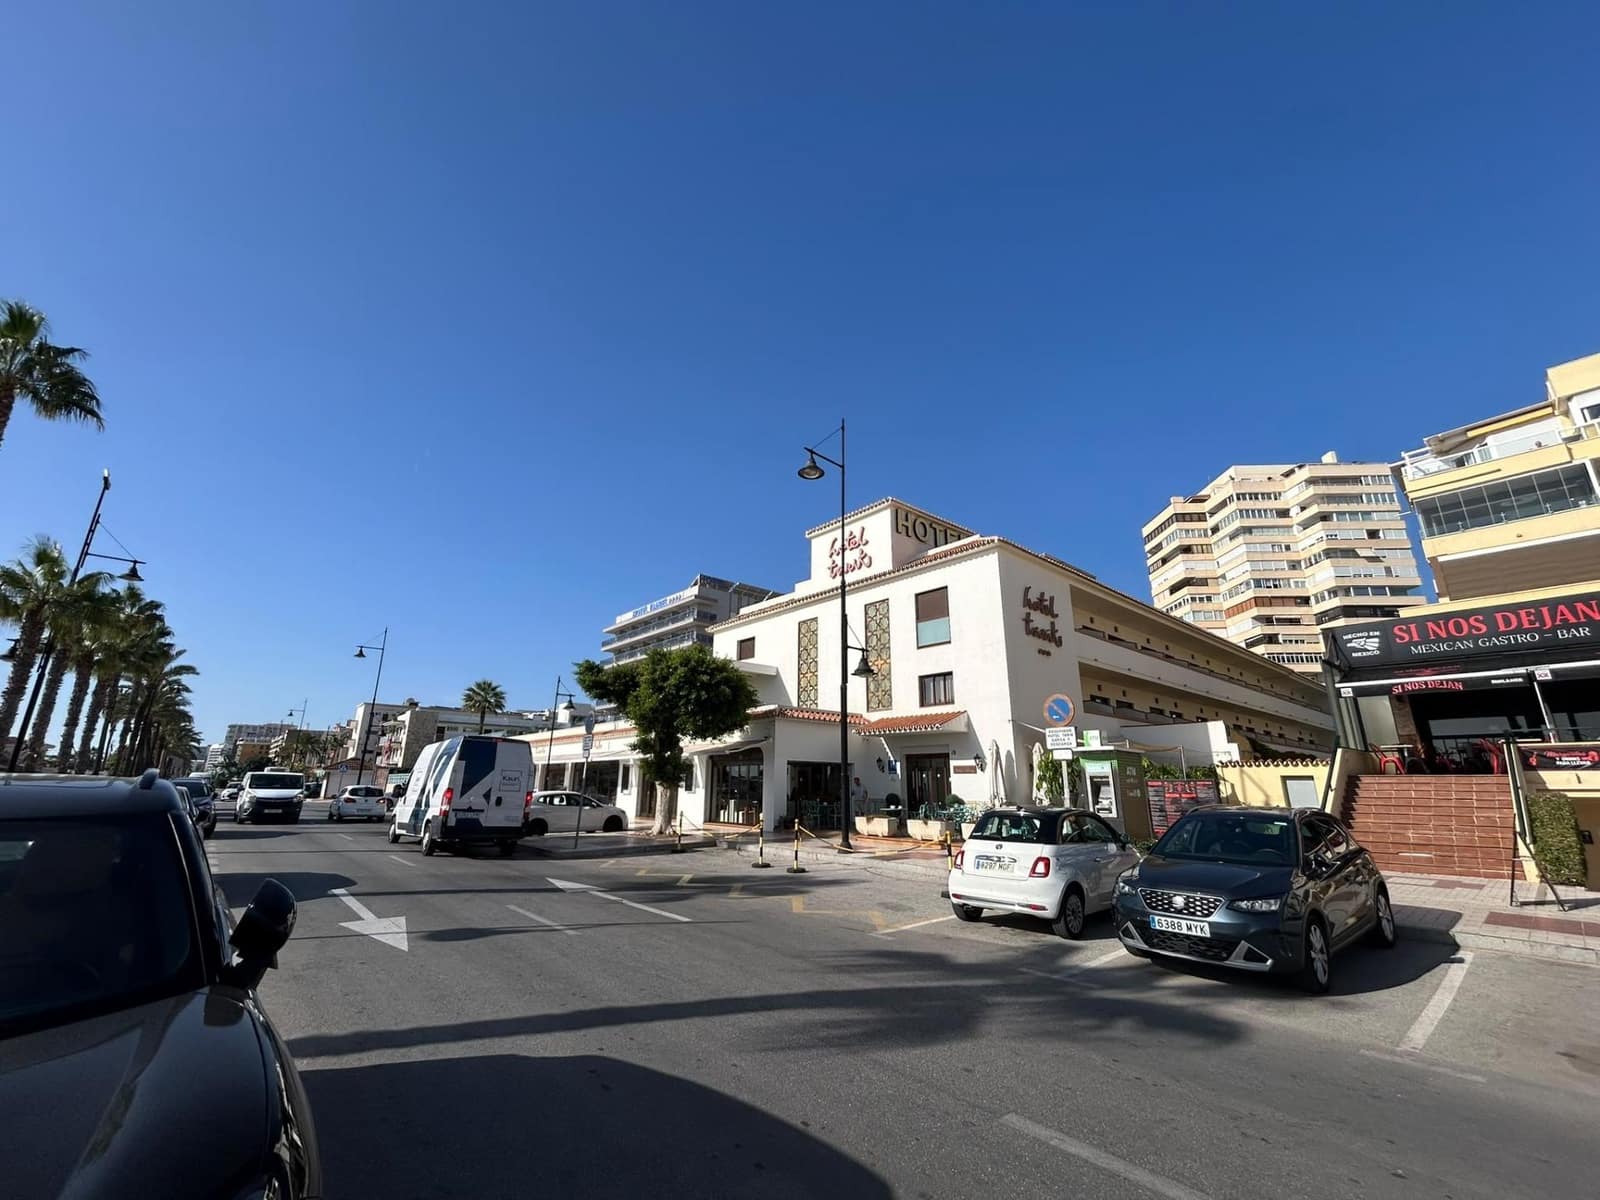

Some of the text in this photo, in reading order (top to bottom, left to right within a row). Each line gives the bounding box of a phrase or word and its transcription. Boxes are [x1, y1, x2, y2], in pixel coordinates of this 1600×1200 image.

[895, 508, 968, 548] HOTE
[1023, 585, 1059, 618] hotel
[1343, 631, 1368, 640] HECHO
[1392, 600, 1600, 643] SI NOS DEJAN
[1410, 639, 1474, 655] MEXICAN
[1478, 632, 1540, 647] GASTRO
[1557, 626, 1592, 639] BAR
[1392, 680, 1464, 695] SI NOS DEJAN
[1157, 919, 1207, 936] 6388 MYK
